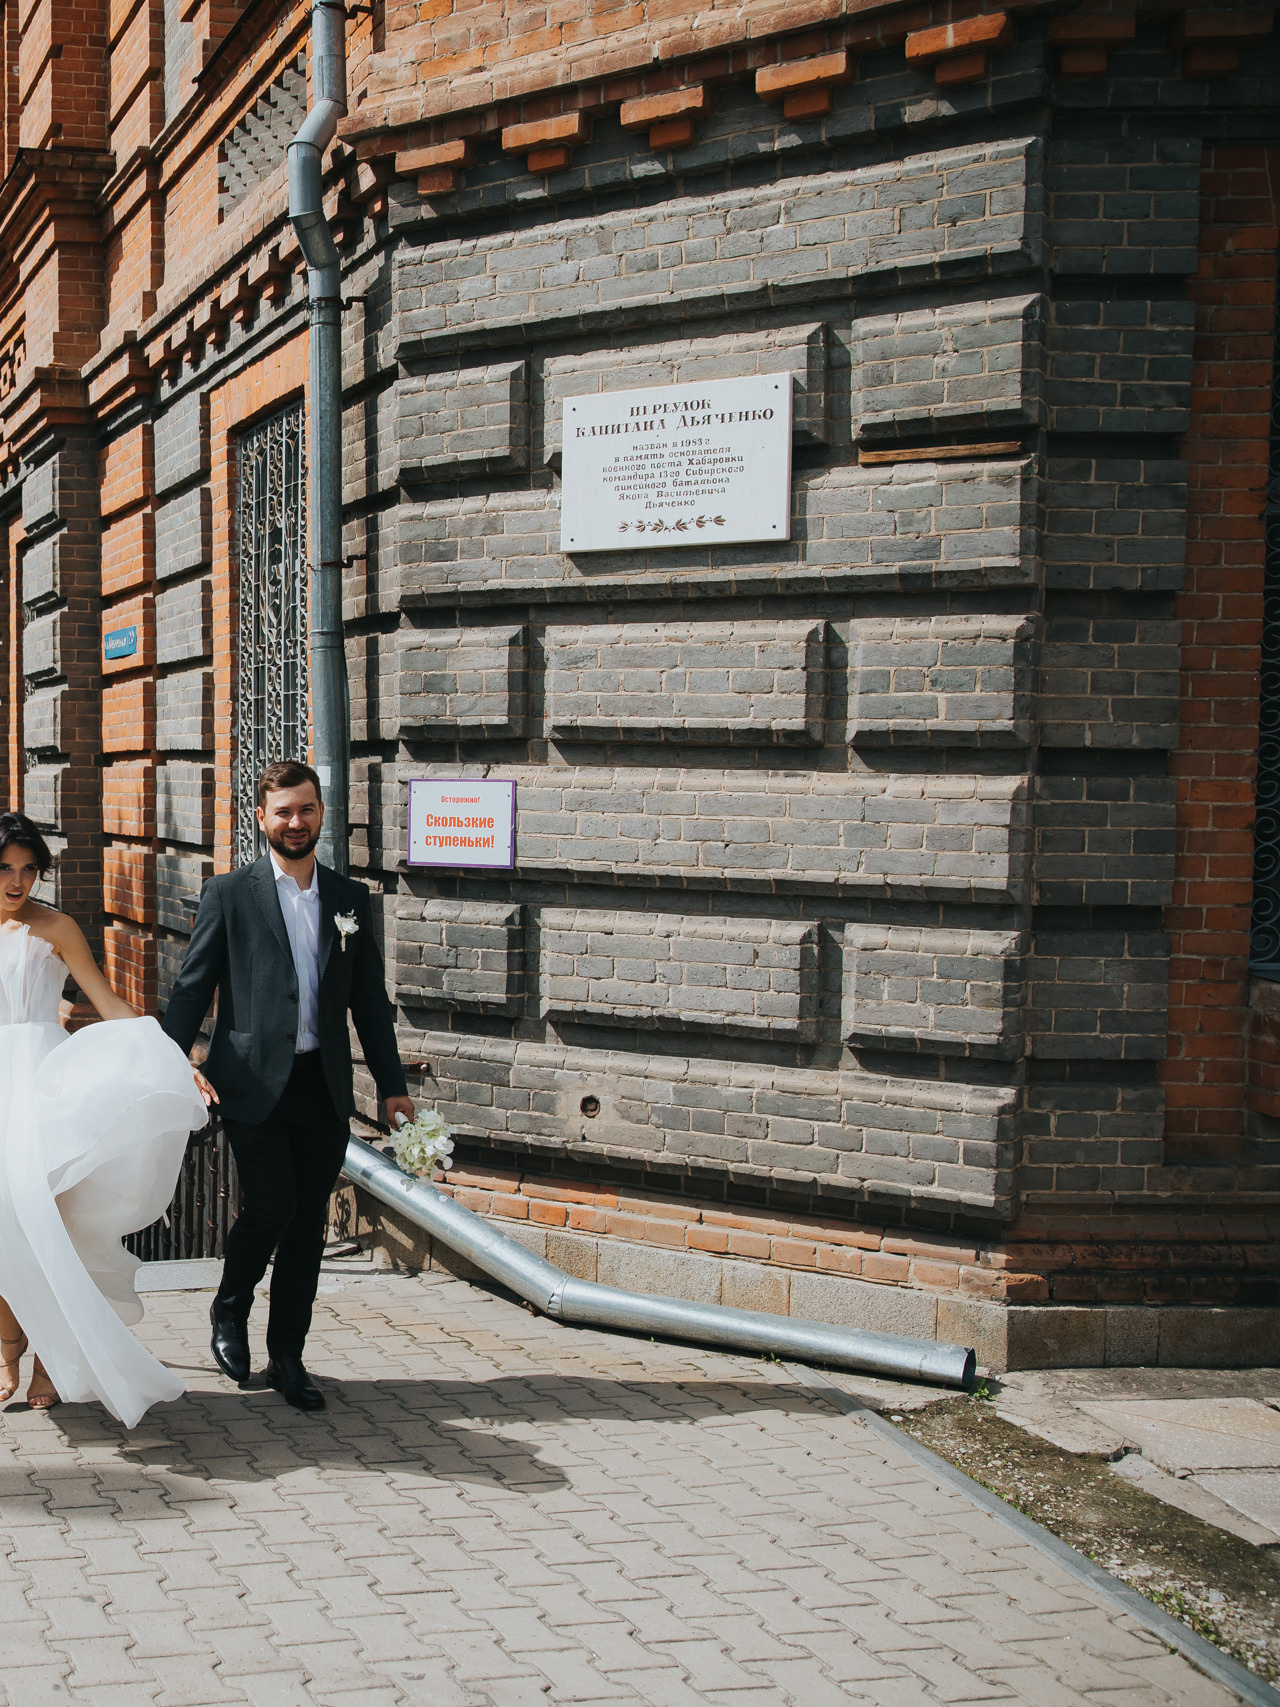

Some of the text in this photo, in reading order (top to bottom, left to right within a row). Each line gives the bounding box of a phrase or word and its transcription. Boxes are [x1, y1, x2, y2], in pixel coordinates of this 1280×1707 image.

[630, 399, 712, 417] ПЕРЕУЛОК
[576, 408, 774, 438] КАПИТАНА ДЬЯЧЕНКО
[624, 452, 665, 462] память
[669, 447, 731, 458] основателя
[632, 442, 668, 452] назван
[602, 455, 744, 473] военного поста Хабаровки
[603, 472, 655, 482] командира
[686, 465, 744, 476] Сибирского
[614, 477, 730, 492] линейного батальона
[619, 486, 726, 501] Якова Васильевича
[645, 499, 696, 509] Дьяченко
[440, 795, 481, 804] Осторожно!
[426, 813, 495, 829] Скользкие
[425, 834, 495, 849] ступеньки!
